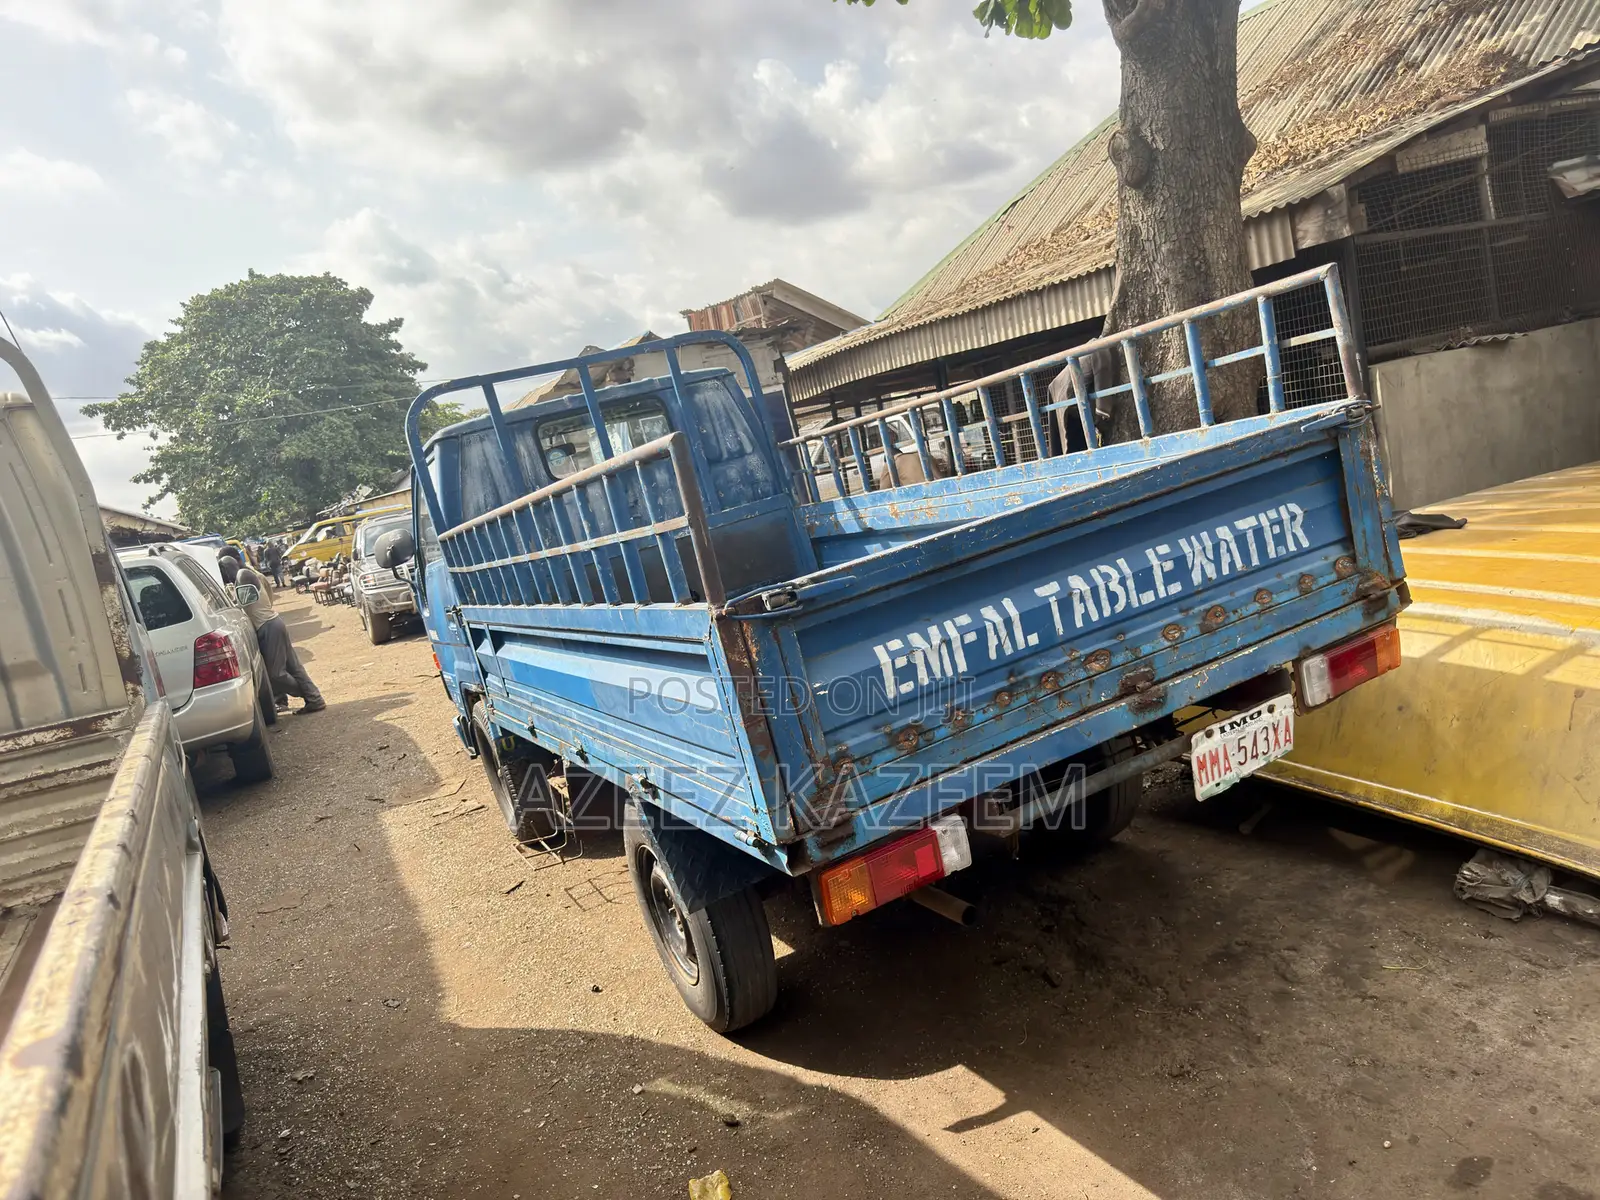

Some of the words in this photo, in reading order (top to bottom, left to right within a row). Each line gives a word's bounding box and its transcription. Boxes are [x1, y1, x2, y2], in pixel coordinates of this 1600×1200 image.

[873, 597, 1039, 699] EMFAL
[1034, 544, 1183, 636] TABLE
[1178, 502, 1310, 587] WATER
[1218, 709, 1262, 735] IMO
